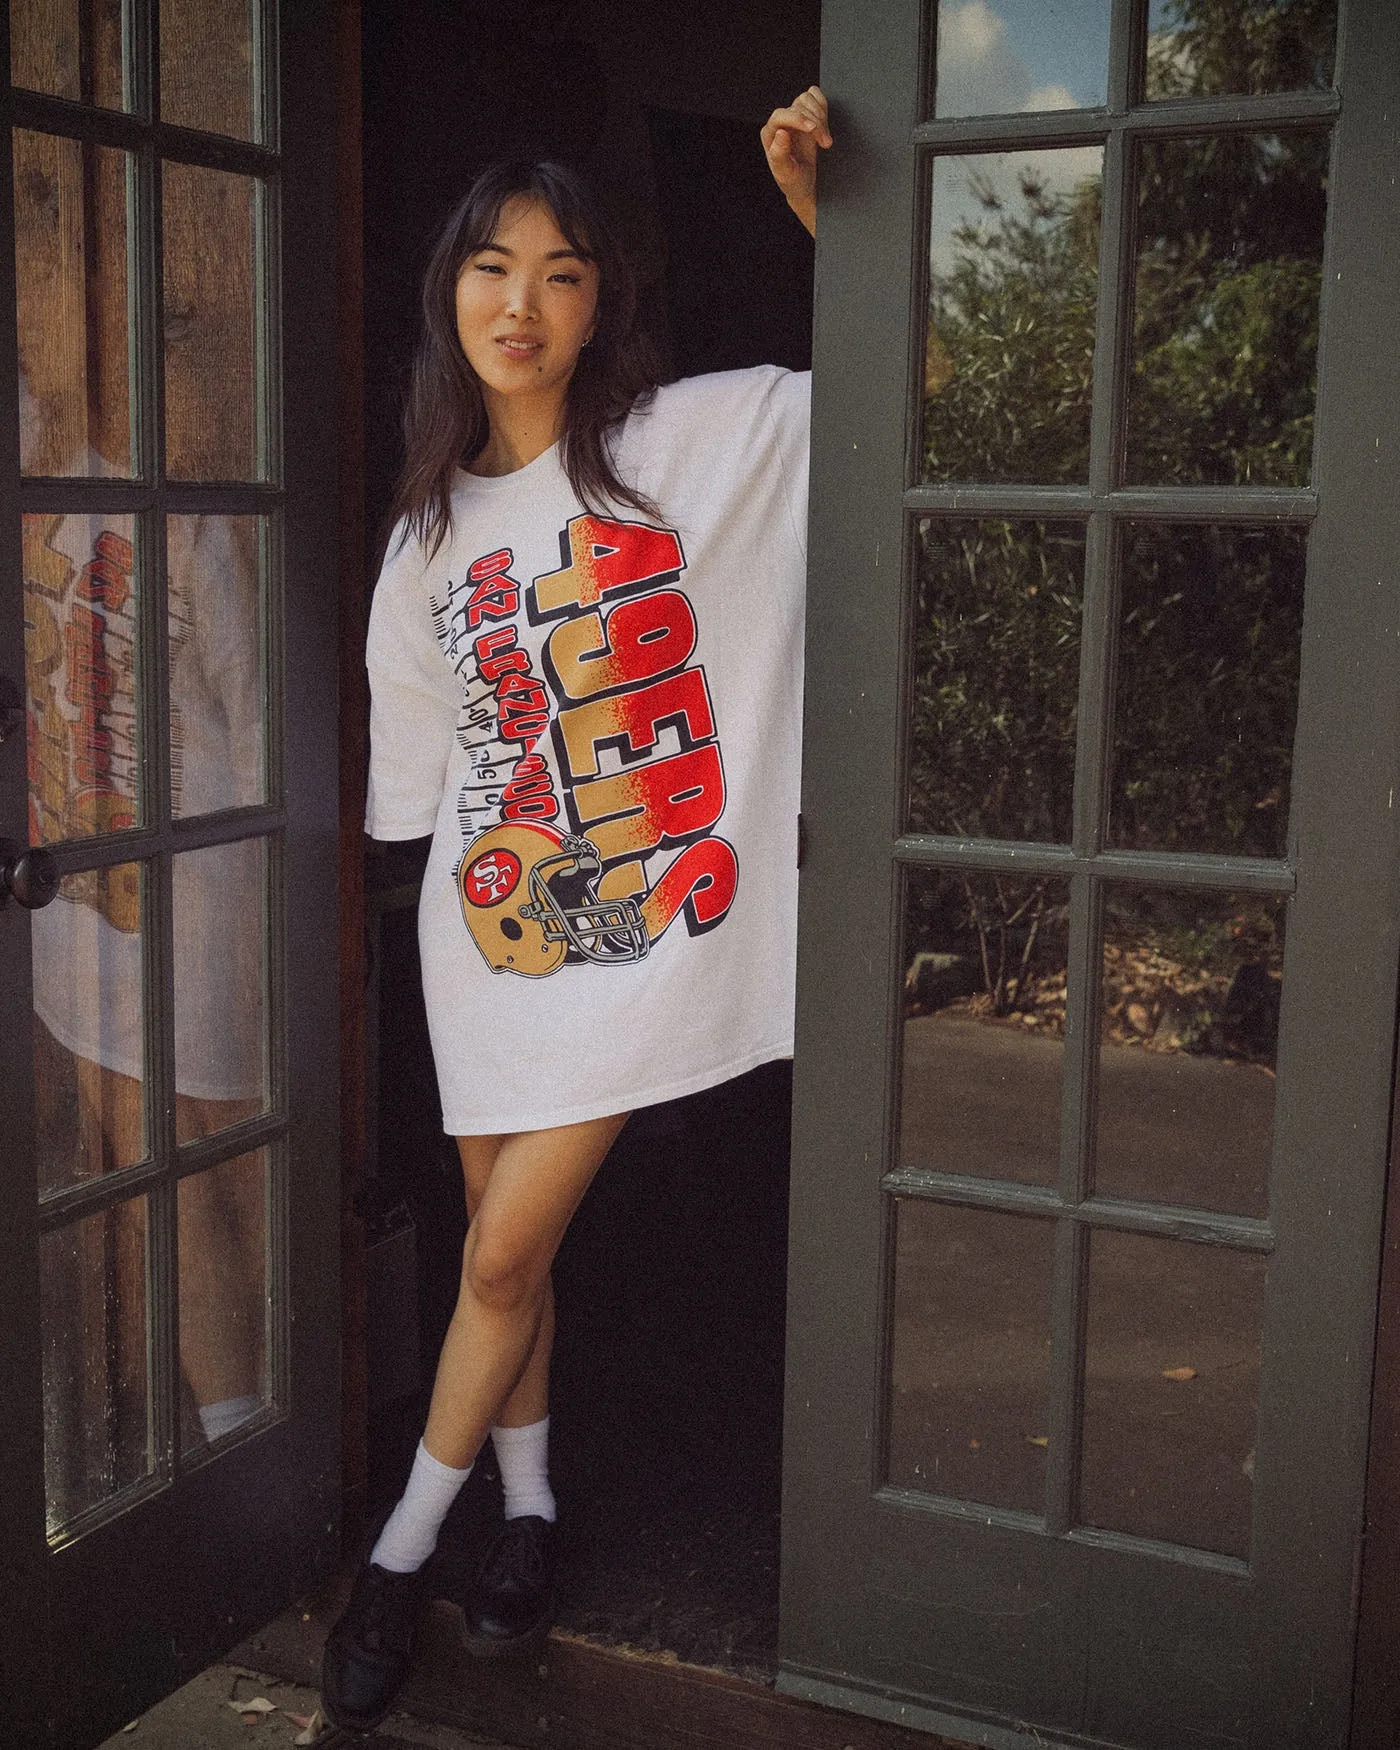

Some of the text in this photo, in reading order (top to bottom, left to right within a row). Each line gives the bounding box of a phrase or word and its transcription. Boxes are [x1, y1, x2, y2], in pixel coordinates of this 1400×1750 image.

[466, 547, 521, 634] SAN
[526, 514, 739, 940] 49ERS
[473, 854, 513, 902] SF
